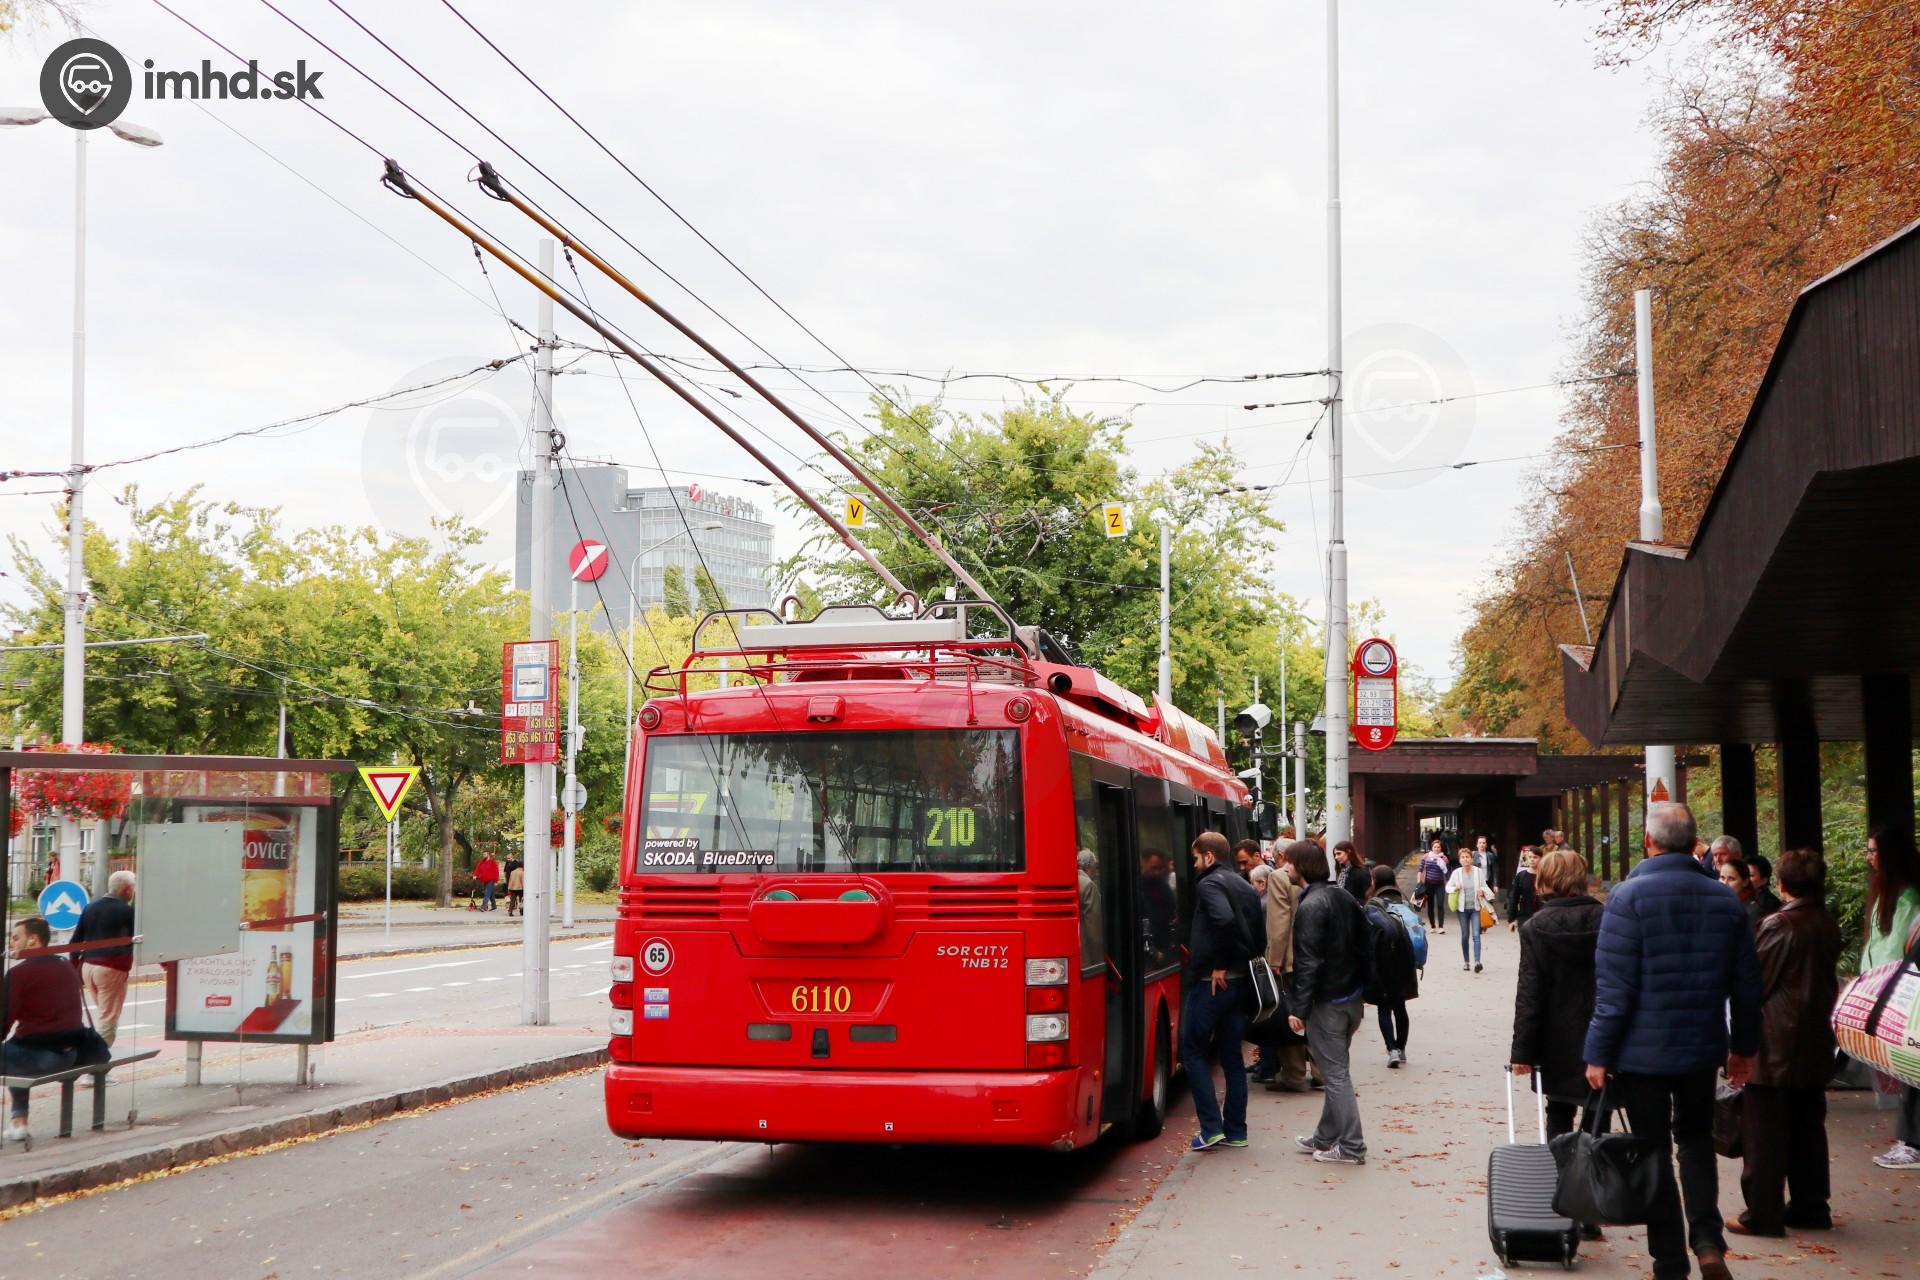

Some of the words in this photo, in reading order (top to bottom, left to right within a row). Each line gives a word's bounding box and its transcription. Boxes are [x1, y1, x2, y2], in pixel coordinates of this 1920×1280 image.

[849, 503, 860, 520] V
[1109, 513, 1121, 528] Z
[927, 807, 975, 846] 210
[645, 838, 685, 850] powered
[687, 838, 699, 850] by
[644, 852, 695, 865] SKODA
[703, 851, 774, 865] BlueDrive
[650, 948, 665, 963] 65
[936, 946, 970, 956] SOR
[973, 946, 1009, 956] CITY
[962, 958, 991, 968] TNB
[993, 958, 1009, 968] 12
[792, 985, 851, 1012] 6110
